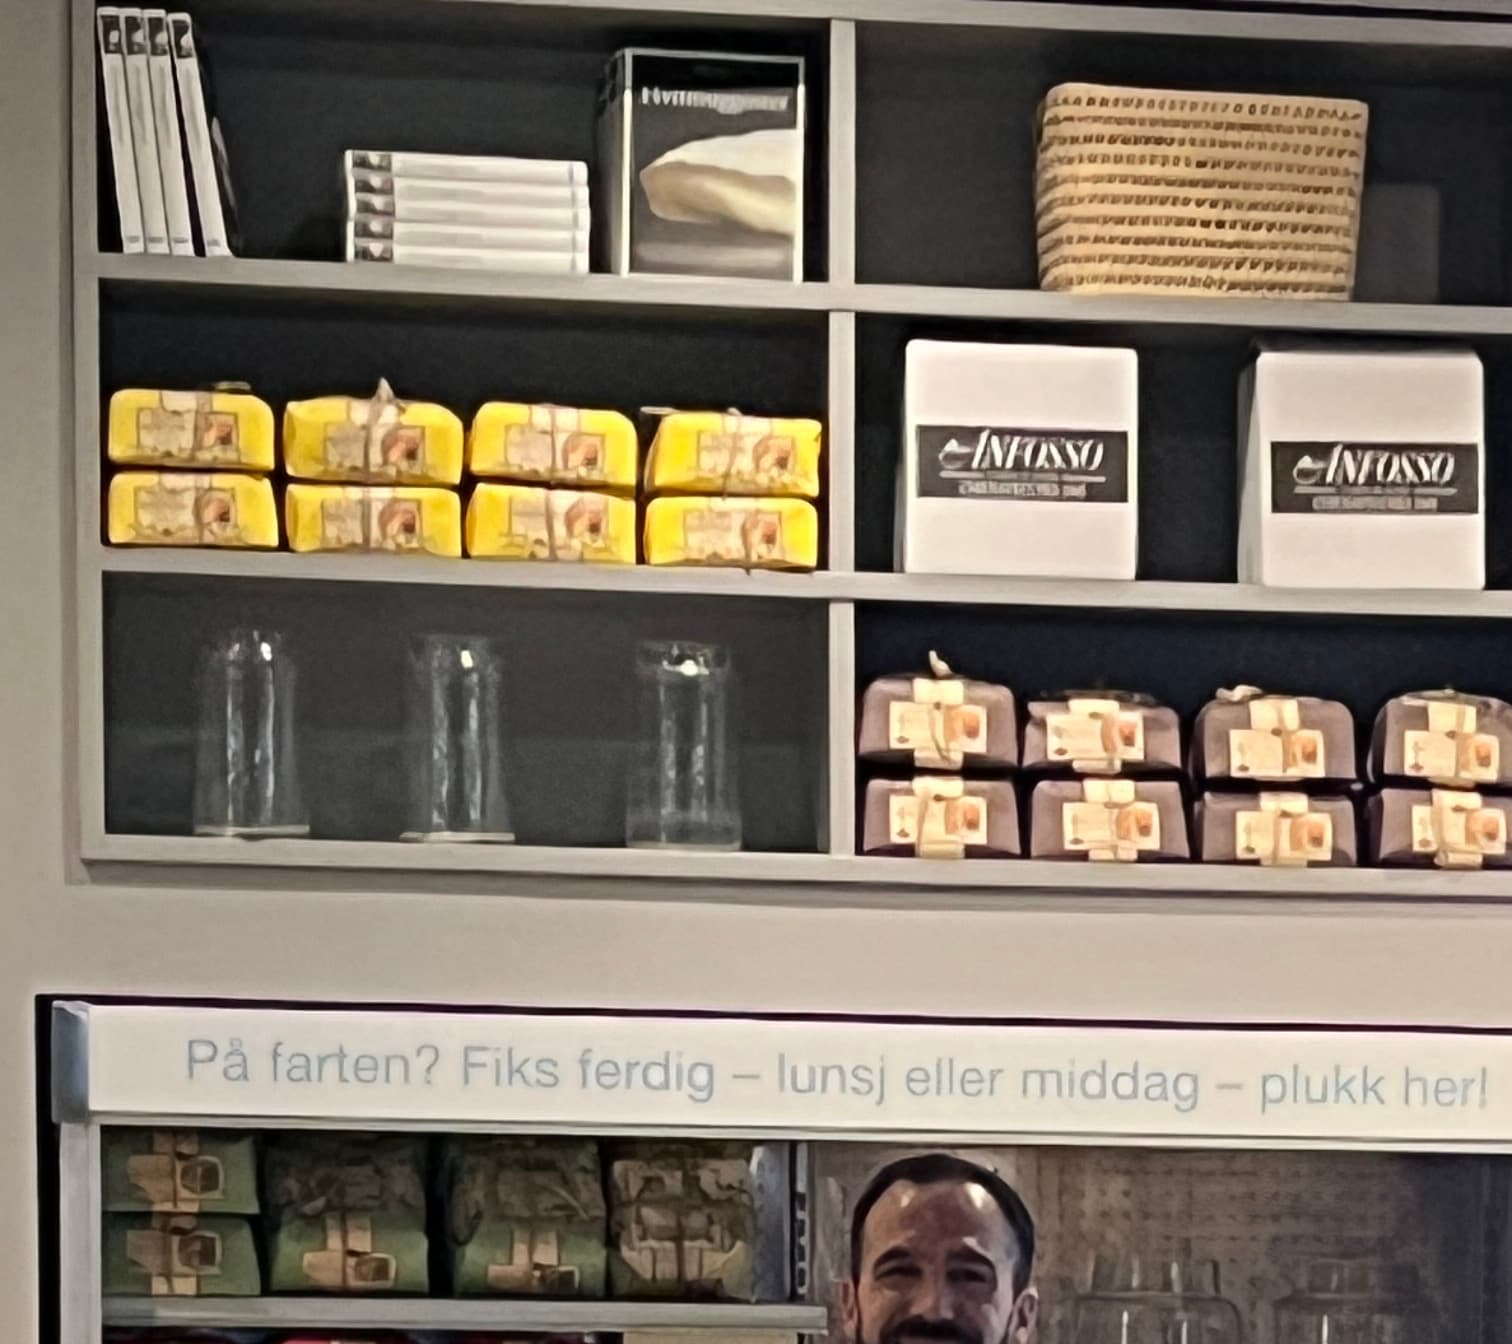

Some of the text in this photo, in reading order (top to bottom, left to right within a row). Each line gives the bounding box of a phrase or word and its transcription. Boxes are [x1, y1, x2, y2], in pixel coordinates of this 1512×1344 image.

[186, 1038, 250, 1082] På
[271, 1041, 440, 1086] farten?
[462, 1045, 560, 1088] Fiks
[578, 1048, 715, 1103] ferdig
[777, 1052, 886, 1105] lunsj
[904, 1057, 1004, 1098] eller
[1021, 1058, 1200, 1113] middag
[1260, 1063, 1386, 1115] plukk
[1402, 1065, 1488, 1109] her!
